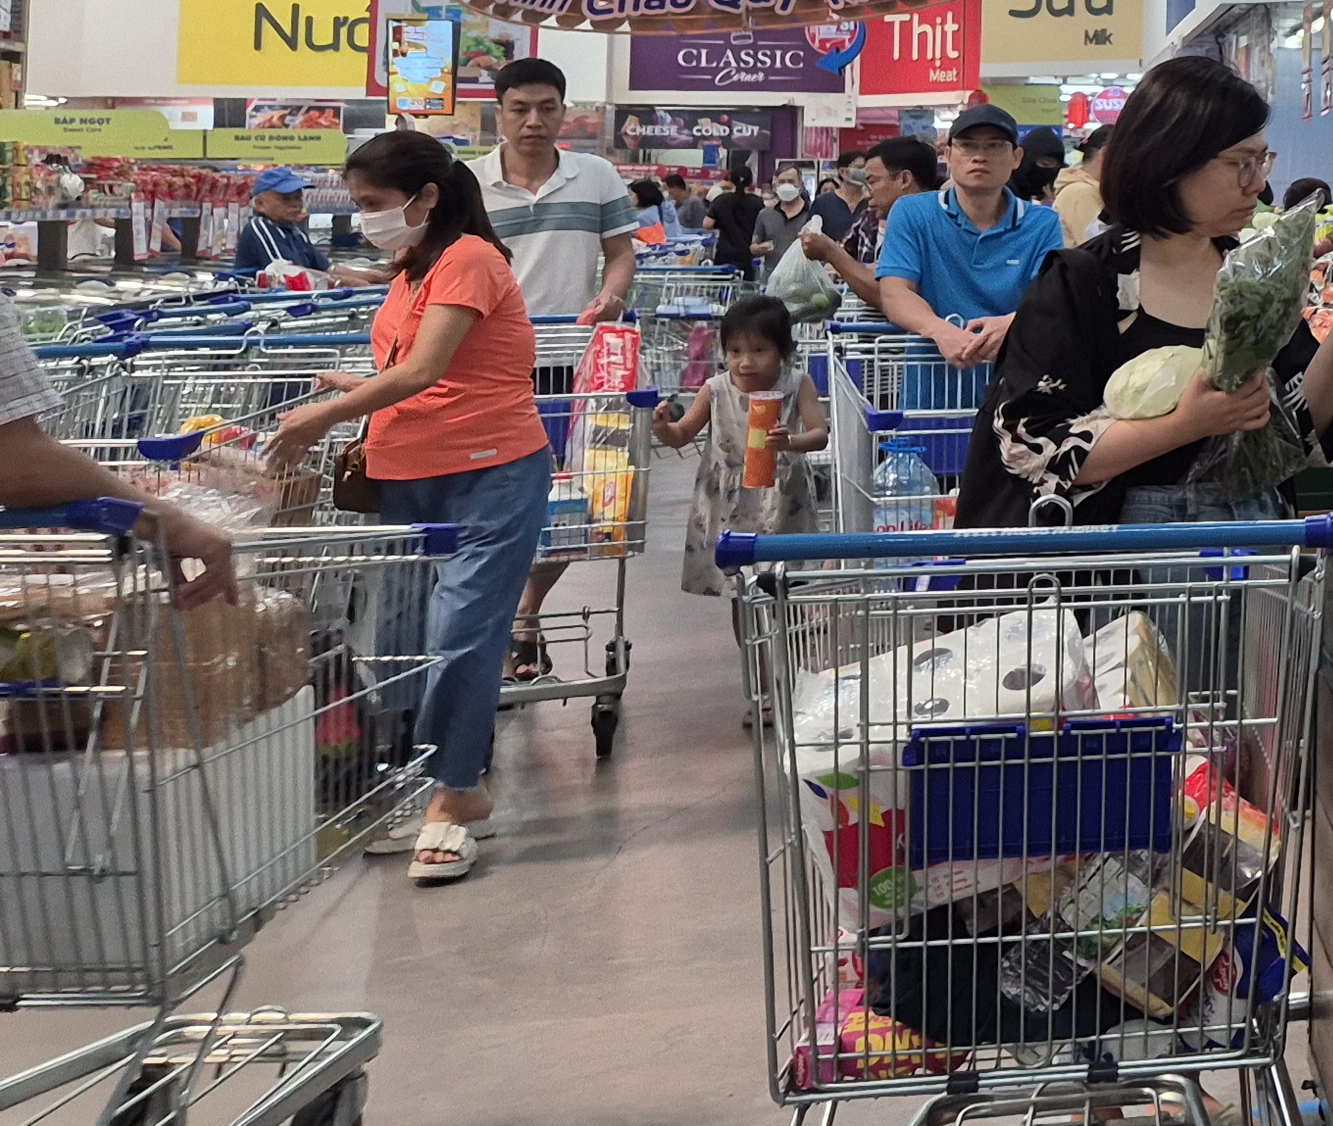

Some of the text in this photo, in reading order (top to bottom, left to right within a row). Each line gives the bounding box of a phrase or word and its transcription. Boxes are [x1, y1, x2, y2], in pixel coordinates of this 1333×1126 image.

[253, 0, 373, 52] Nướ
[883, 10, 960, 67] Thịt
[676, 48, 804, 70] CLASSIC
[714, 67, 766, 87] Corner
[928, 68, 958, 84] Meat
[625, 123, 760, 138] CHEESE COLD CUT
